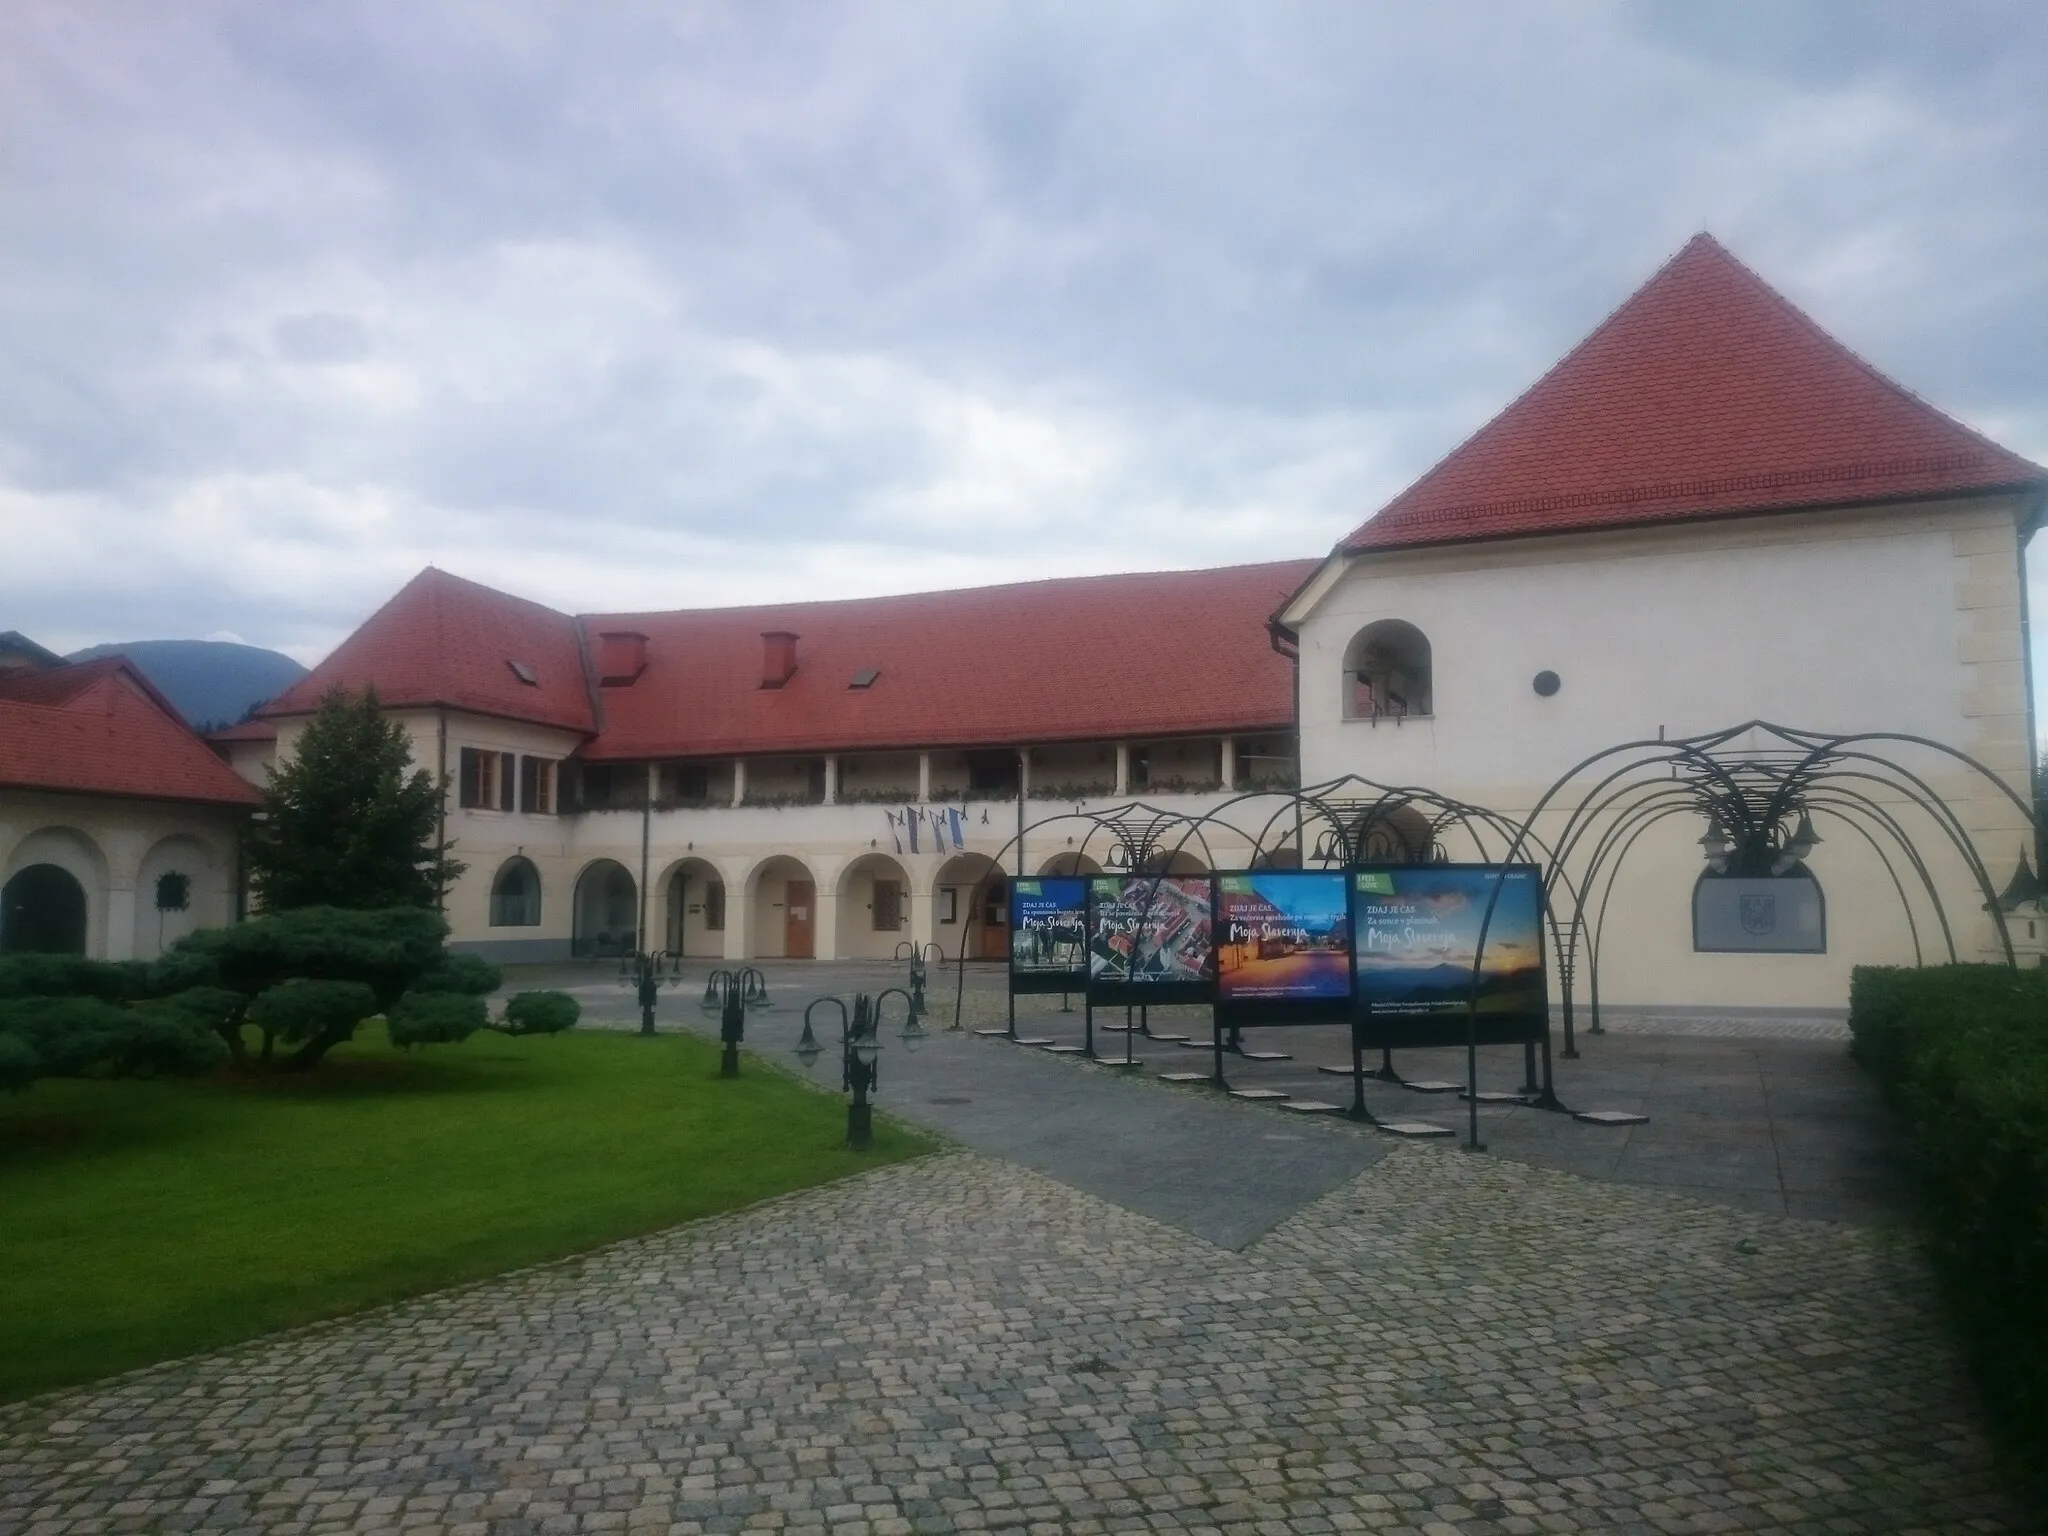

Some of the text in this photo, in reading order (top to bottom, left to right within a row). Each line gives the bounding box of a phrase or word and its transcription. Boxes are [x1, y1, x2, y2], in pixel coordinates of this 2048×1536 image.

[1366, 905, 1388, 914] ZDAJ
[1388, 905, 1399, 914] JE
[1022, 915, 1085, 933] Moja Slovenija
[1099, 917, 1125, 935] Moja
[1367, 917, 1377, 925] Za
[1230, 922, 1310, 944] Moja Slovenija
[1367, 926, 1457, 952] Moja Slovenija
